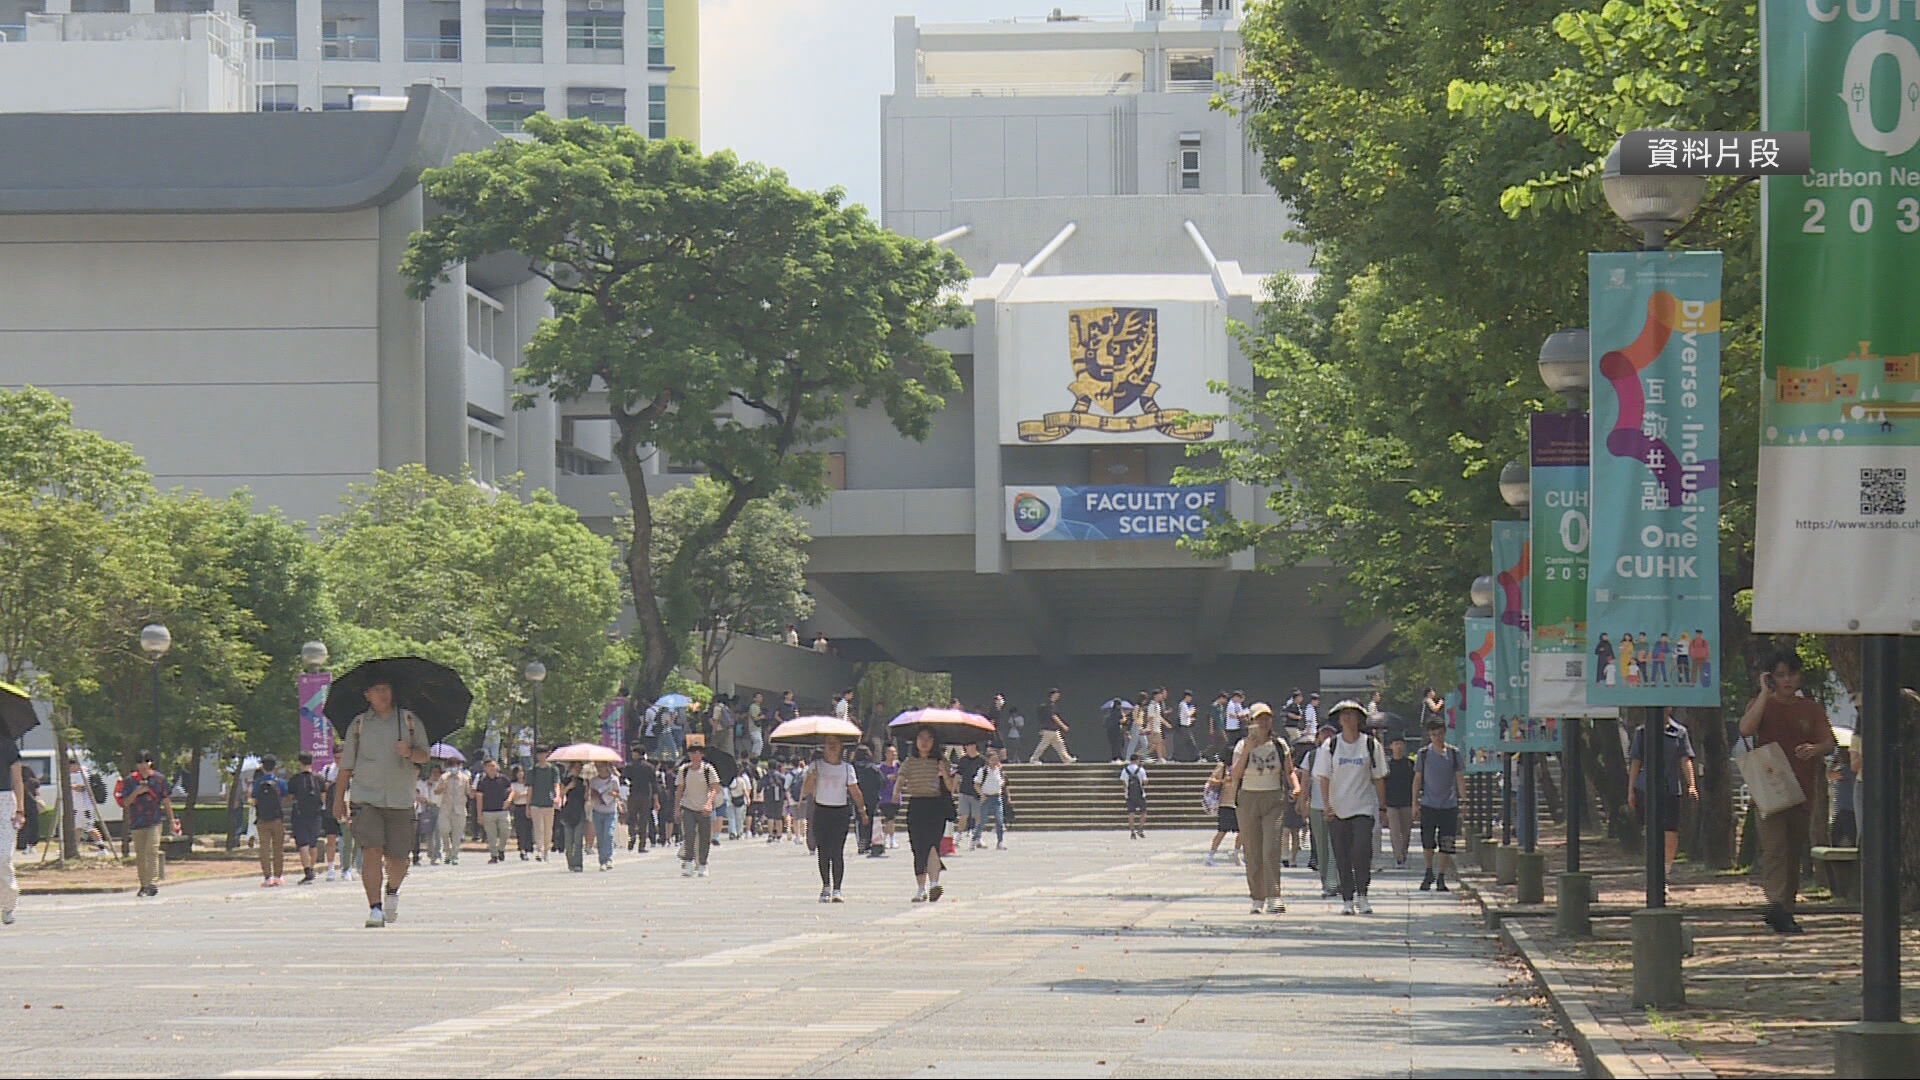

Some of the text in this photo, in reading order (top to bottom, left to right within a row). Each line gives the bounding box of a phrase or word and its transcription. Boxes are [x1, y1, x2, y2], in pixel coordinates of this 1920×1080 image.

[1802, 167, 1883, 188] Carbon
[1681, 300, 1705, 409] Diverse
[1642, 378, 1670, 512] 互敬共融
[1086, 492, 1216, 511] FACULTY OF
[1019, 507, 1042, 520] SCI
[1119, 515, 1211, 534] SCIENC
[1641, 525, 1698, 548] One
[1615, 555, 1699, 579] CUHK
